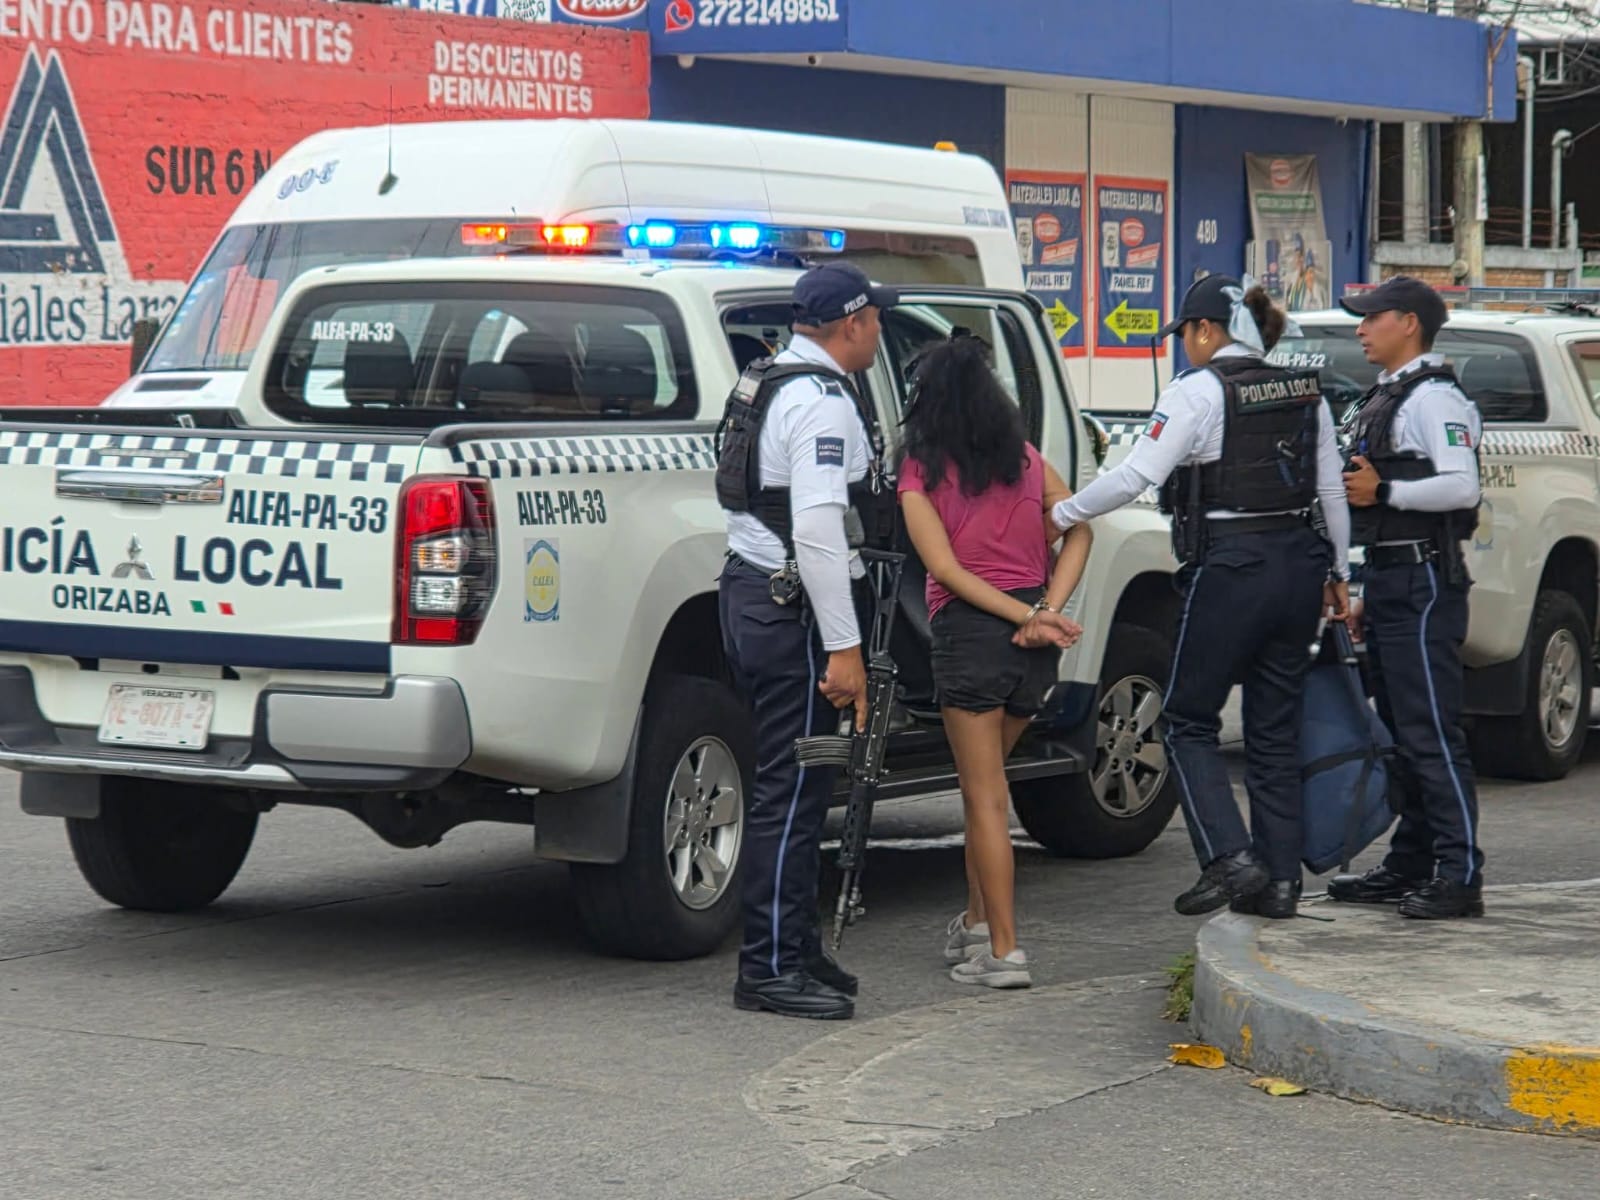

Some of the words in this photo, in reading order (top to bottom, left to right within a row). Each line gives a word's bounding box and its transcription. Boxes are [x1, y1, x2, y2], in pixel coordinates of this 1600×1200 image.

[106, 1, 201, 53] PARA
[207, 9, 354, 64] CLIENTES
[434, 39, 584, 82] DESCUENTOS
[428, 74, 594, 113] PERMANENTES
[145, 145, 217, 196] SUR
[225, 148, 245, 196] 6
[1196, 219, 1218, 244] 480
[311, 320, 395, 343] ALFA-PA-33
[226, 488, 389, 534] ALFA-PA-33
[516, 489, 608, 525] ALFA-PA-33
[173, 534, 343, 590] LOCAL
[52, 584, 172, 617] ORIZABA
[142, 689, 184, 699] VERACRUZ
